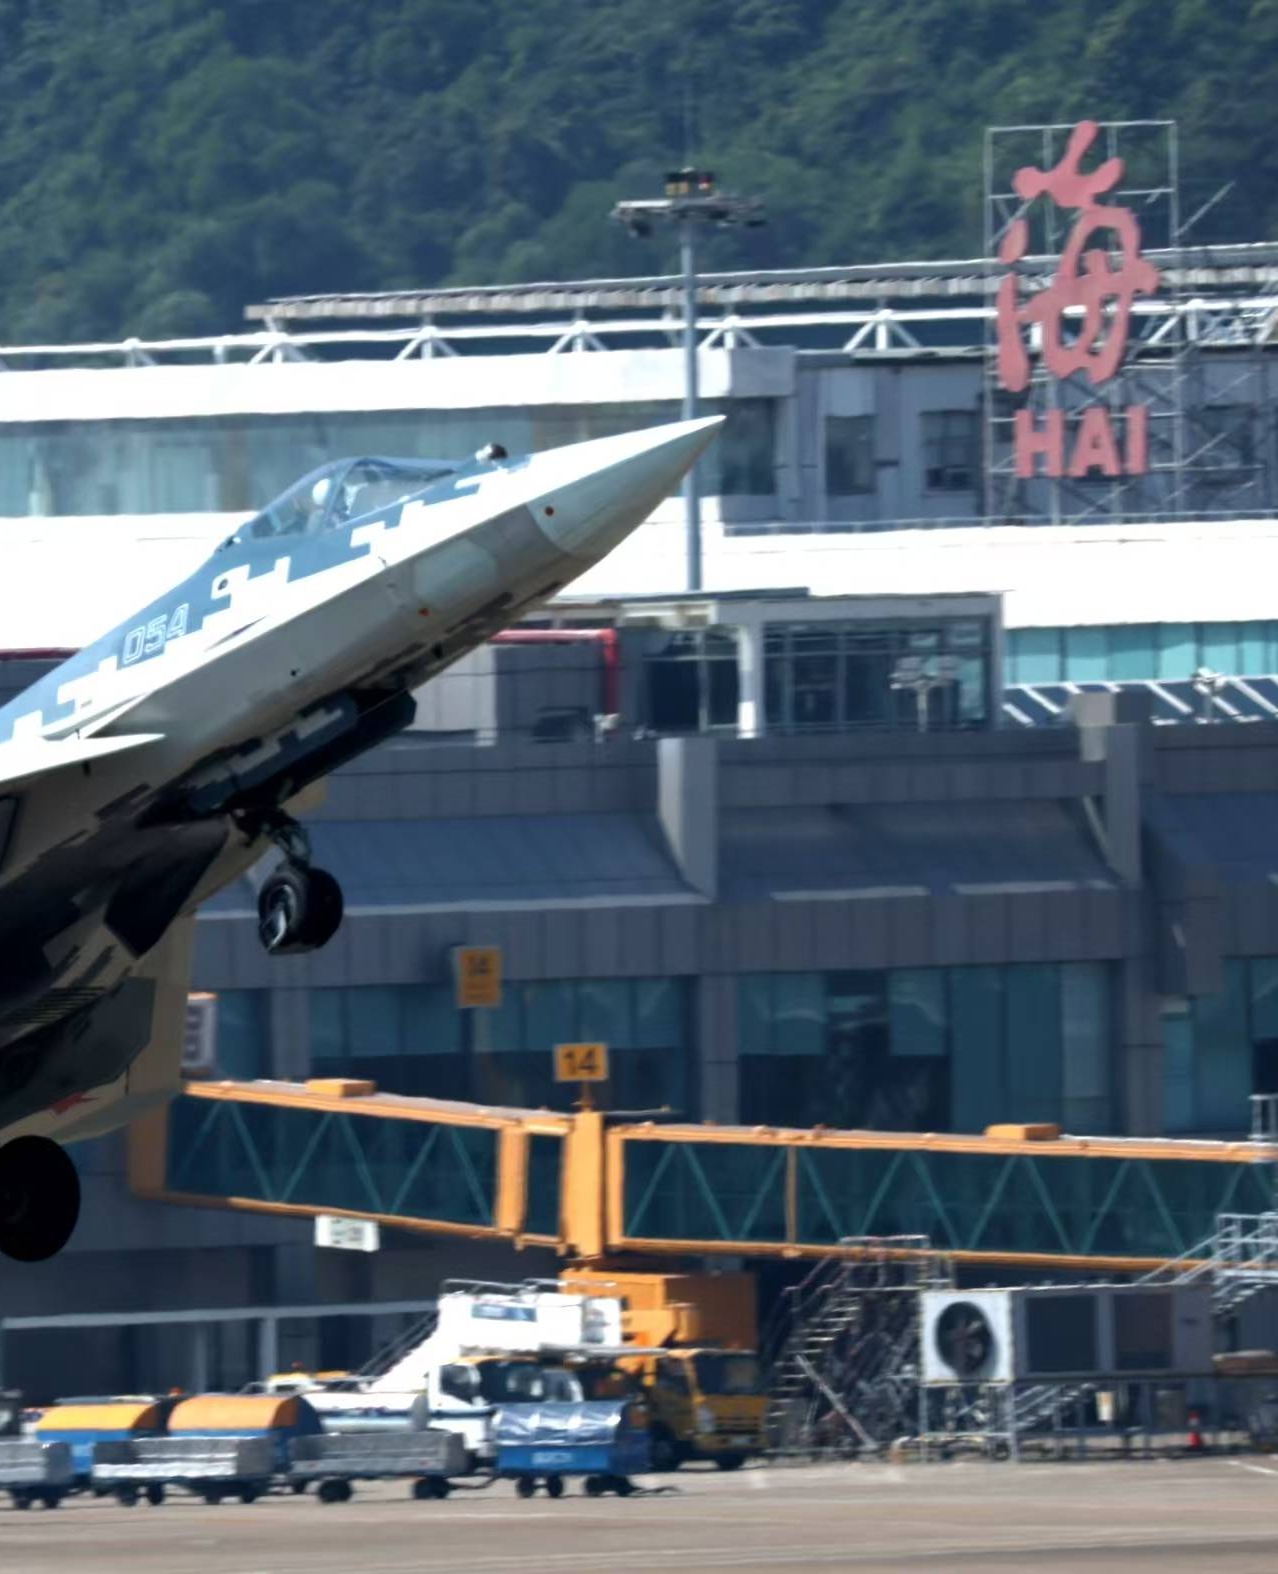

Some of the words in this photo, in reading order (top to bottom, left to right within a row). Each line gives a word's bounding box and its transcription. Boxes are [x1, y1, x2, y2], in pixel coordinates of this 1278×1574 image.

[997, 120, 1160, 391] 海
[1015, 405, 1148, 477] HAI
[123, 603, 189, 665] 054
[562, 1047, 599, 1076] 14
